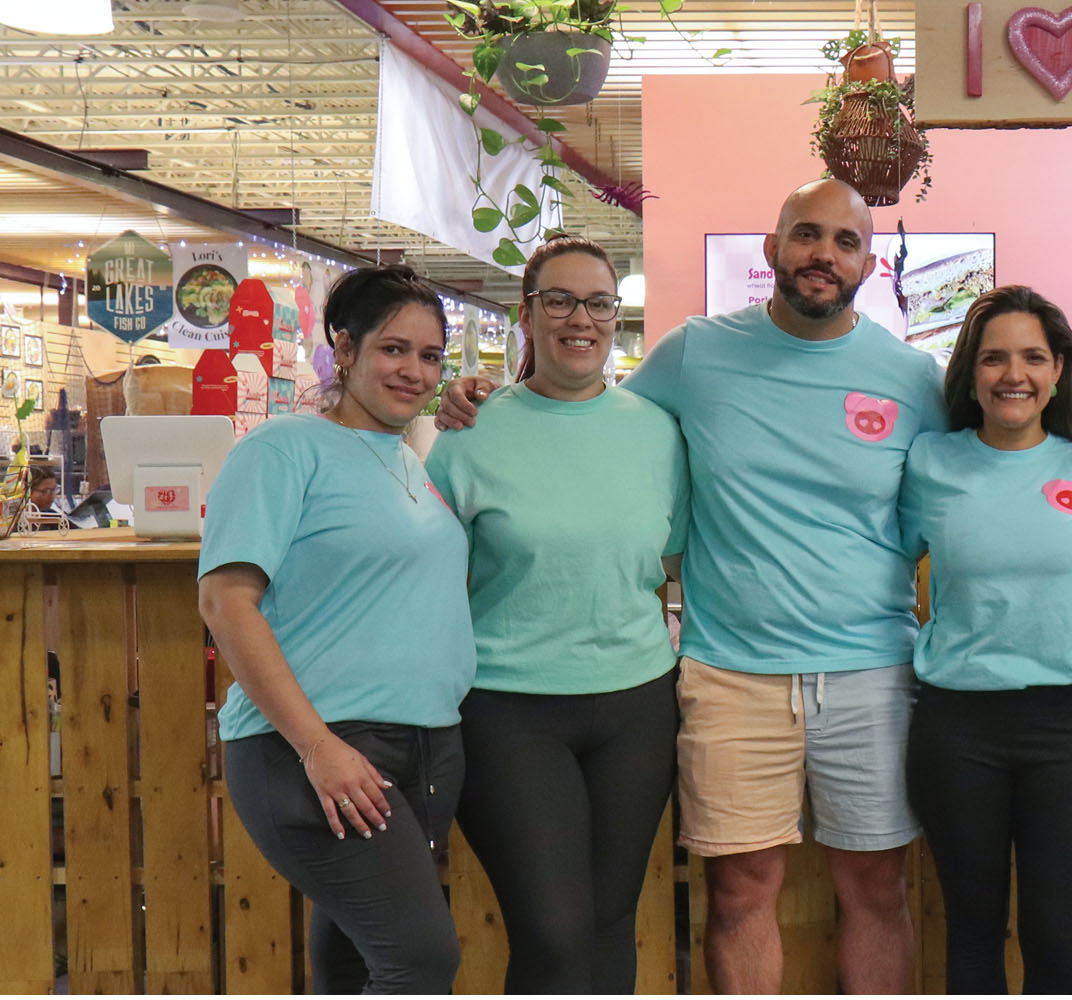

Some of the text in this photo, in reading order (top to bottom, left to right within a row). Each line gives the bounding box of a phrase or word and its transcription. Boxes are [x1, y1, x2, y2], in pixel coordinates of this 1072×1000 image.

[965, 2, 983, 97] I
[192, 249, 223, 261] Lori's
[104, 257, 155, 285] GREAT
[748, 267, 776, 280] Sand
[105, 283, 154, 315] LAKES
[113, 316, 133, 331] FISH
[171, 320, 202, 341] Clean
